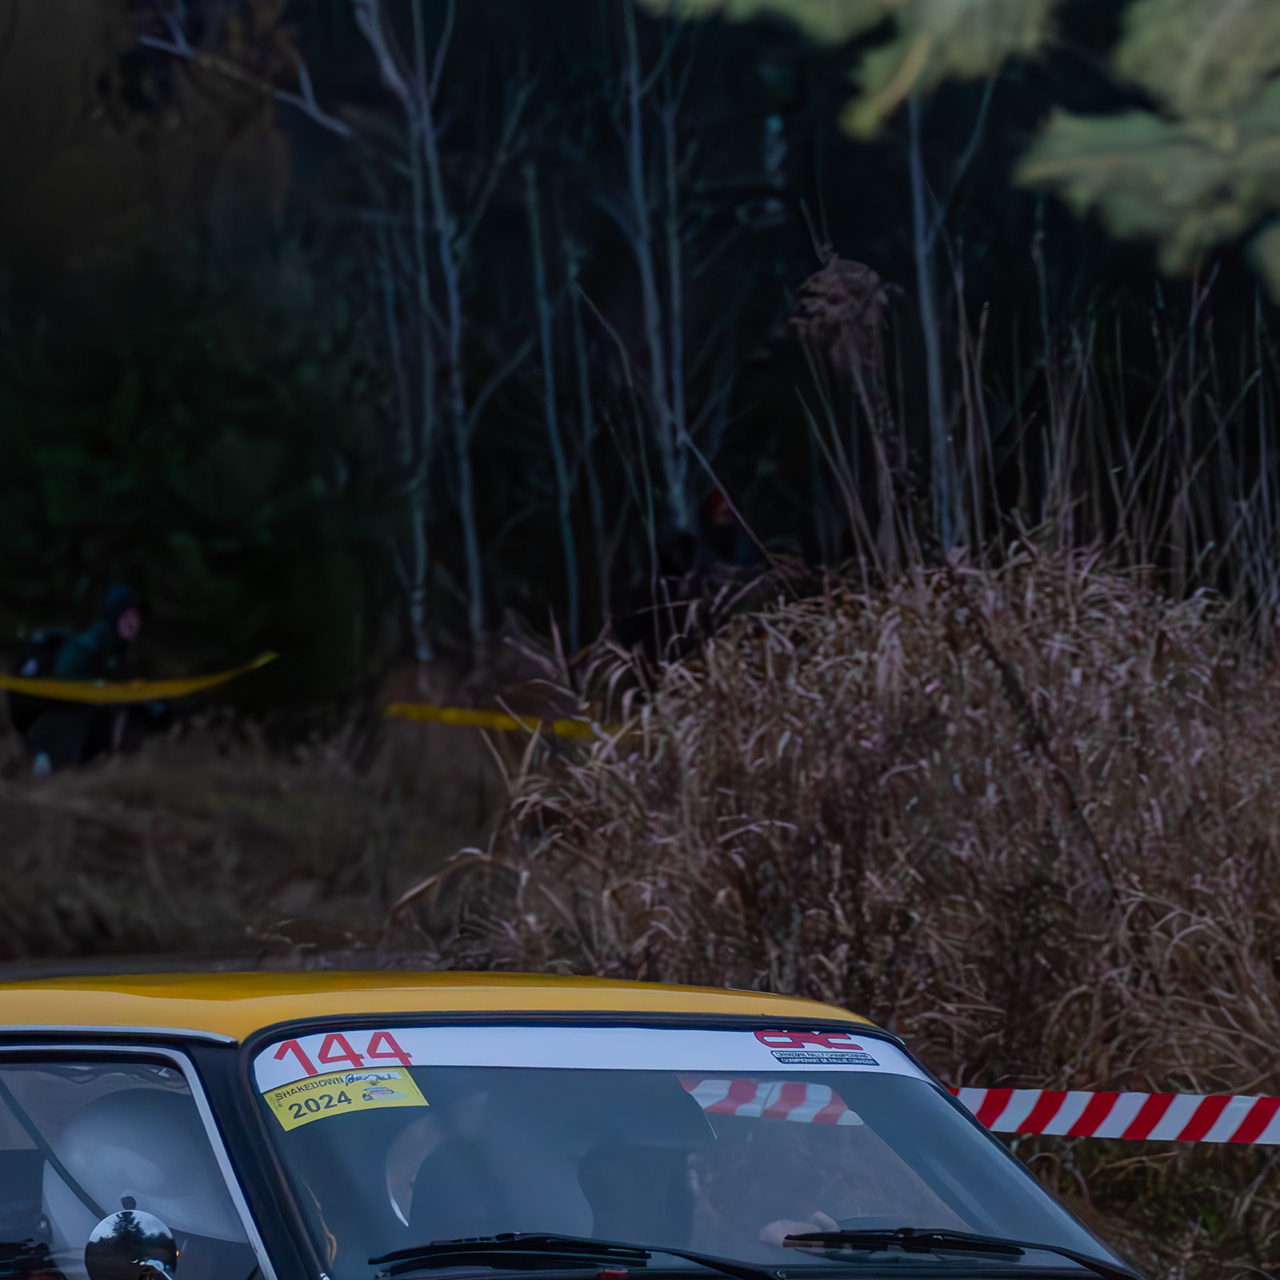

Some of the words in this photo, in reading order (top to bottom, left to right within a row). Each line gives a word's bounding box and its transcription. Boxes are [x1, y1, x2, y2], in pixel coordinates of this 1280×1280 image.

[273, 1031, 413, 1077] 144
[275, 1077, 345, 1101] SHAKEDOWN
[288, 1090, 352, 1120] 2024
